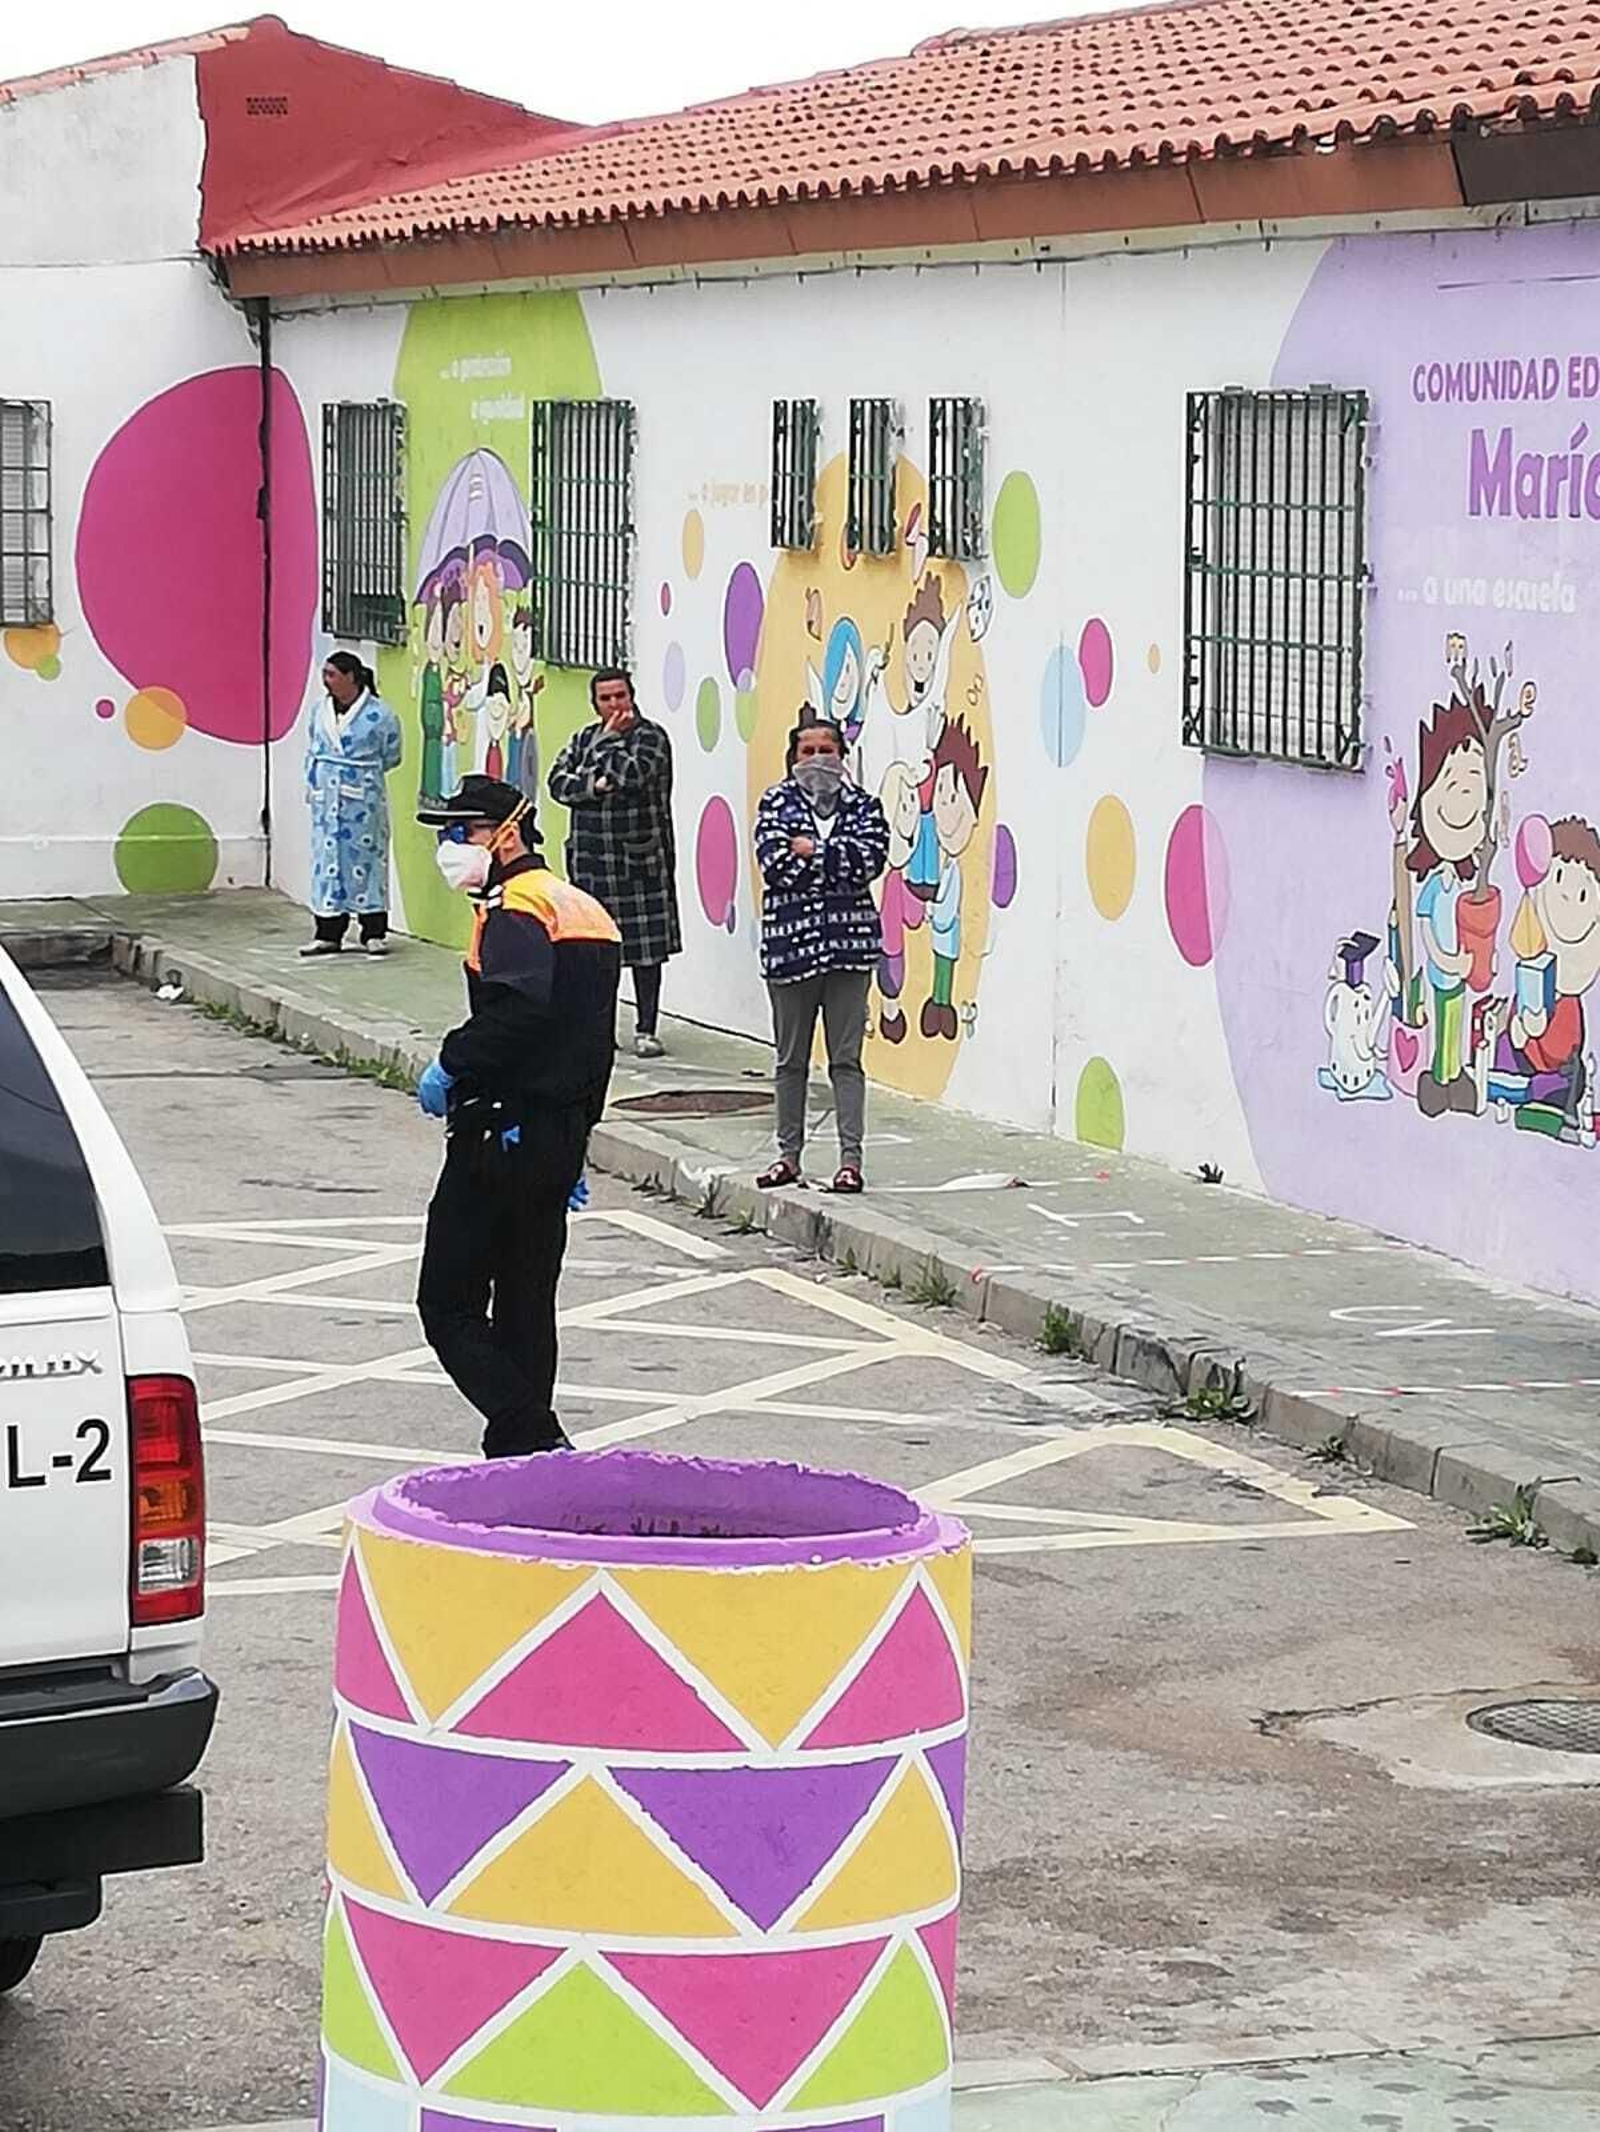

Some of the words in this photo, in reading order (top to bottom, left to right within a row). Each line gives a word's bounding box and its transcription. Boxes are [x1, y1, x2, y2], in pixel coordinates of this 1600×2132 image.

[1412, 358, 1560, 402] COMUNIDAD
[1444, 577, 1487, 607] una
[1492, 571, 1577, 614] escuela
[7, 1418, 112, 1489] L-2
